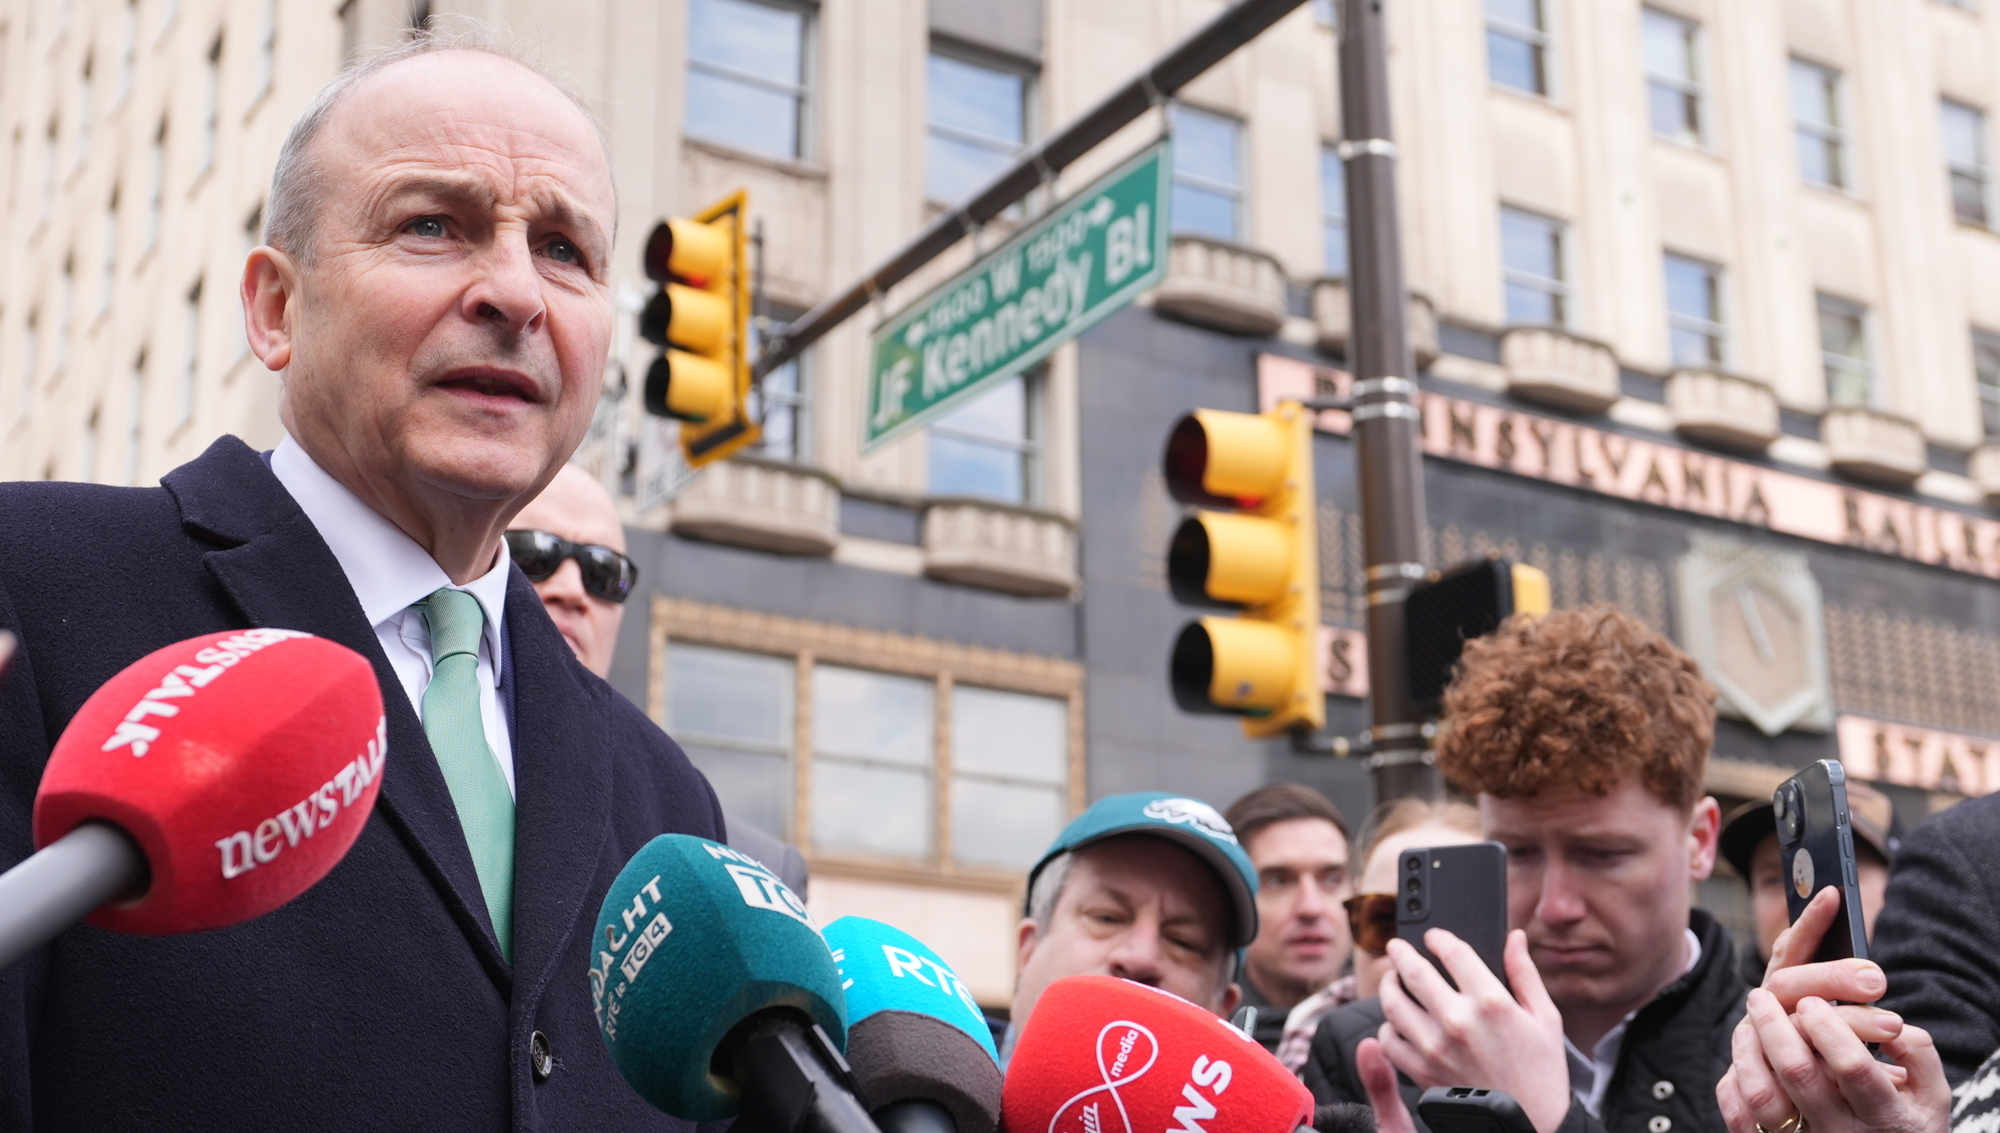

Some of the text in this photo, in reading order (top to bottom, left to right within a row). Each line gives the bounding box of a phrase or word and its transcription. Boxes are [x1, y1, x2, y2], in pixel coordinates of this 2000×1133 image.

[989, 249, 1023, 302] W
[873, 202, 1151, 429] JF Kennedy Bl
[1313, 372, 2000, 568] PNSYLVANIA RAILR
[622, 920, 667, 975] TG4
[1110, 1029, 1138, 1078] media
